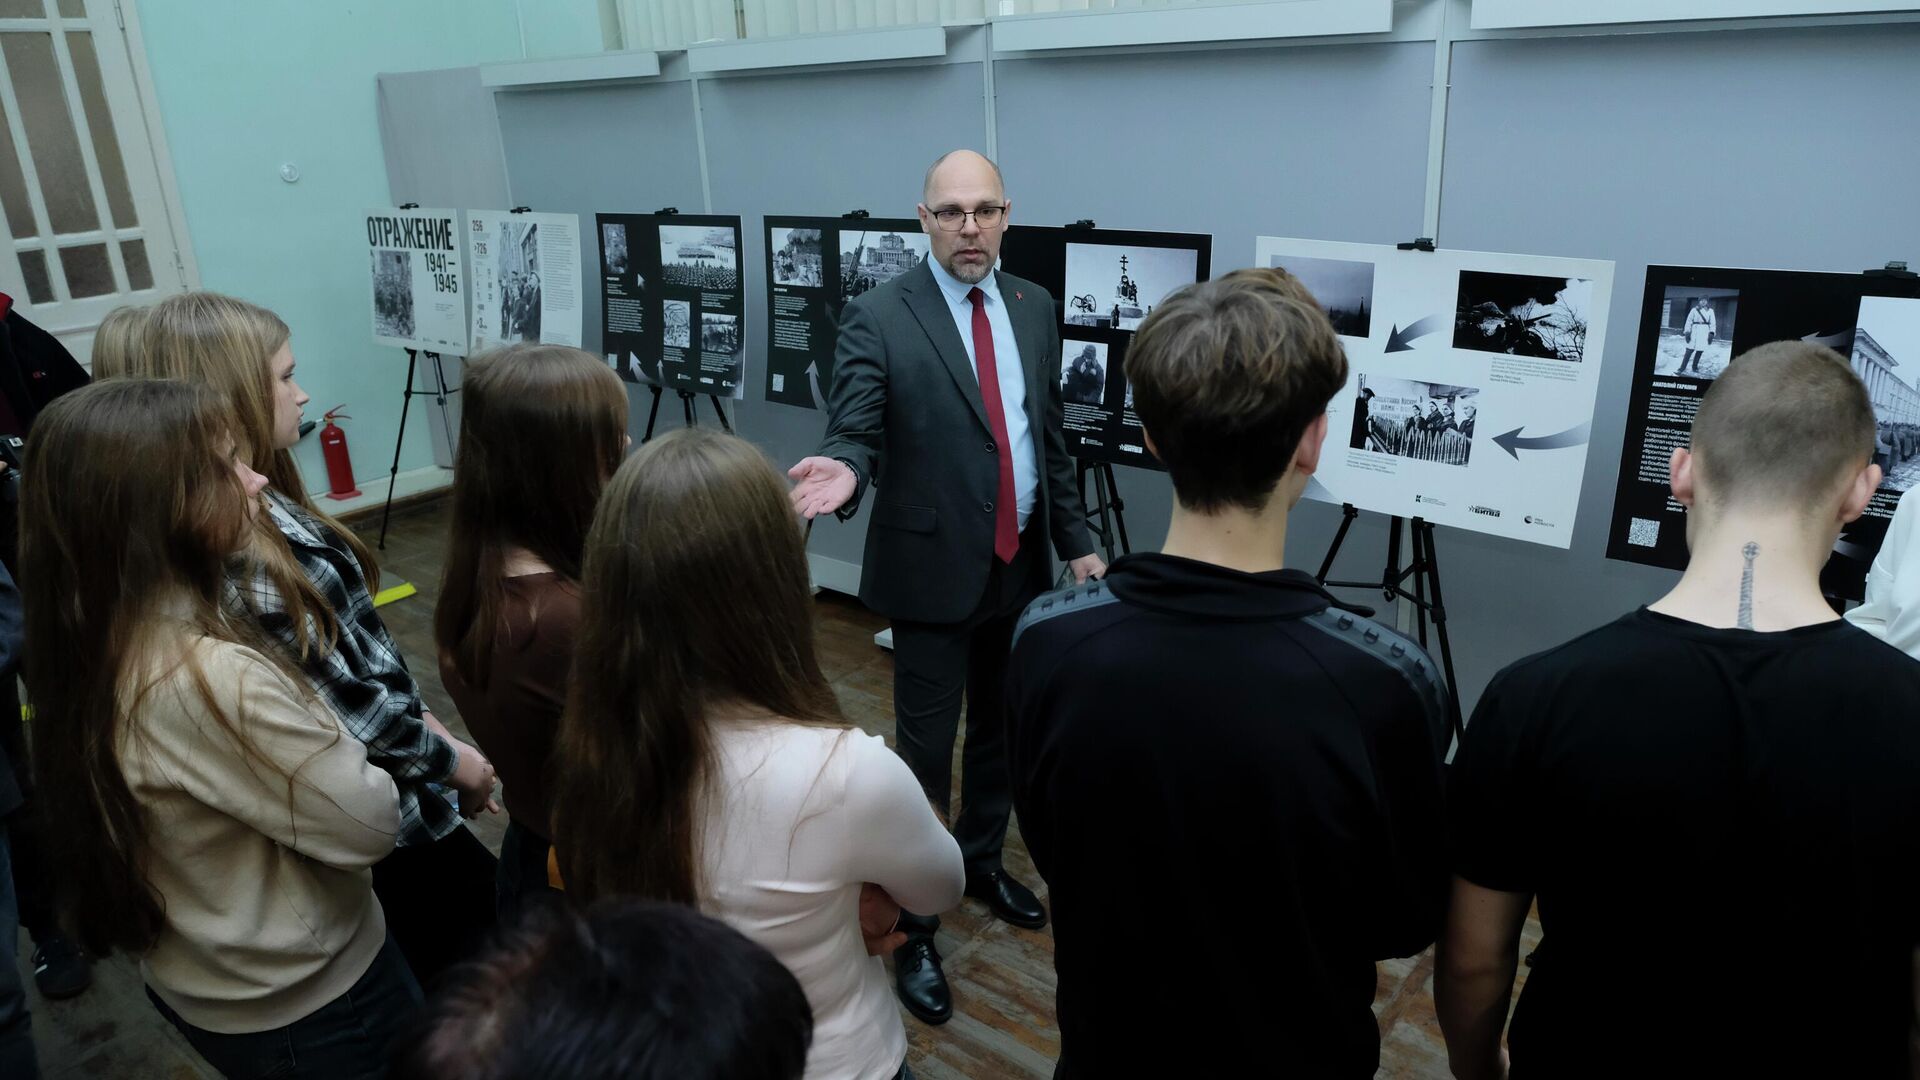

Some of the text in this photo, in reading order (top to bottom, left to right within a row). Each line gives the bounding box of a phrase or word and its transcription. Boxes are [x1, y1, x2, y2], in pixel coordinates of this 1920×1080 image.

[367, 216, 454, 250] ОТРАЖЕНИЕ
[471, 220, 483, 231] 256
[434, 273, 458, 293] 1945
[1646, 426, 1670, 434] Анатолий
